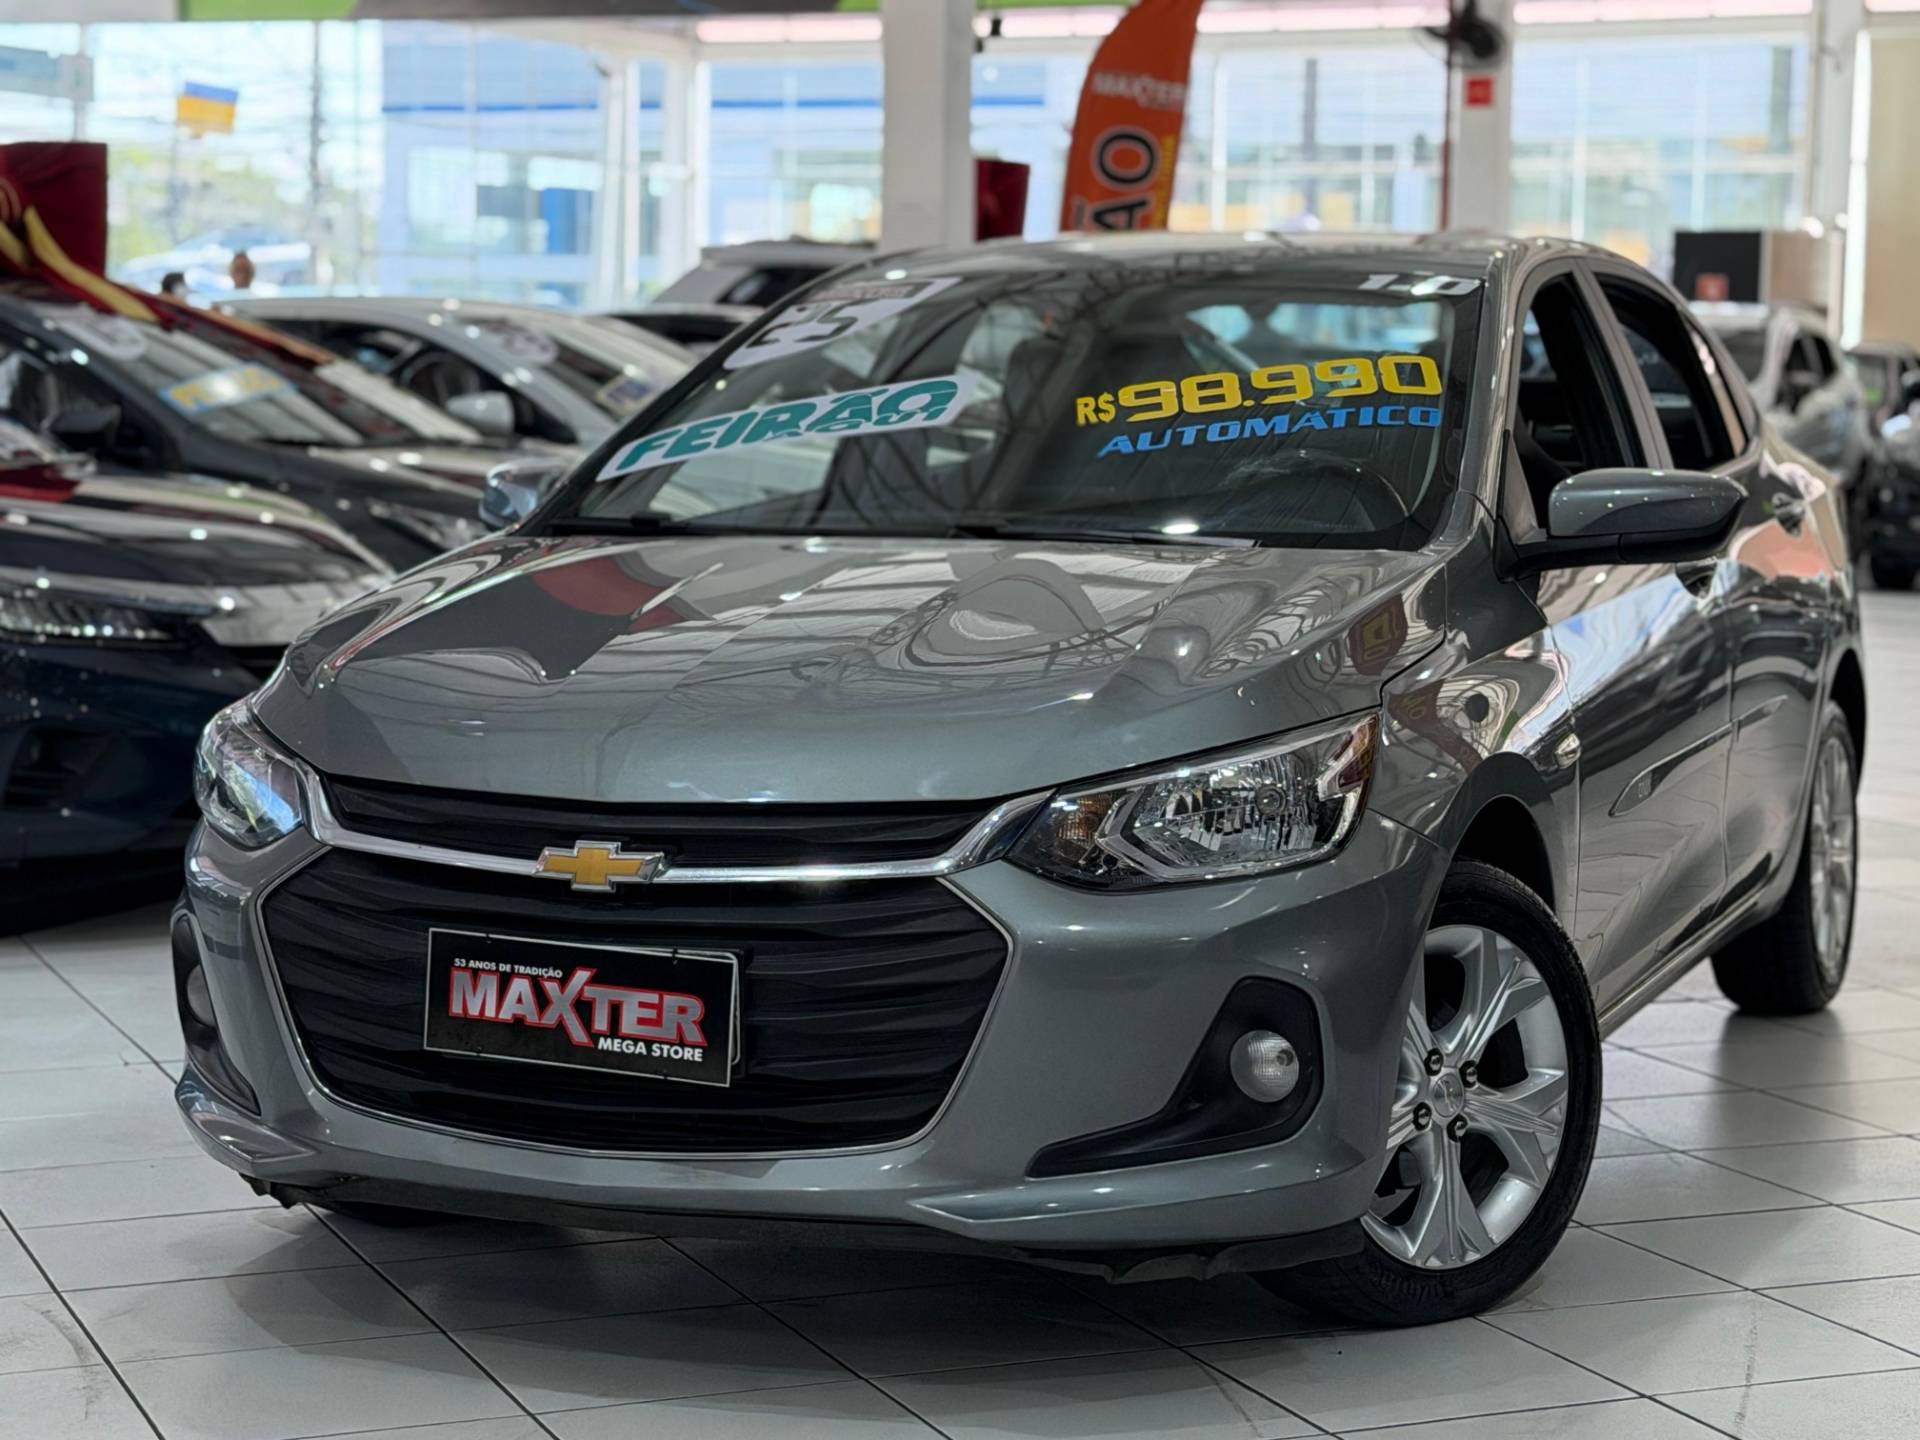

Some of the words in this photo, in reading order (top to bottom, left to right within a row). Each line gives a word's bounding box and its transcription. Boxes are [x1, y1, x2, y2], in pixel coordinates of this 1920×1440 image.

[615, 378, 959, 472] FEIRÃO
[453, 957, 467, 968] 53
[468, 959, 497, 972] ANOS
[498, 963, 512, 973] DE
[513, 964, 563, 979] TRADIÇÃO
[449, 967, 707, 1048] MAXTER
[597, 1037, 647, 1056] MEGA
[650, 1043, 704, 1063] STORE
